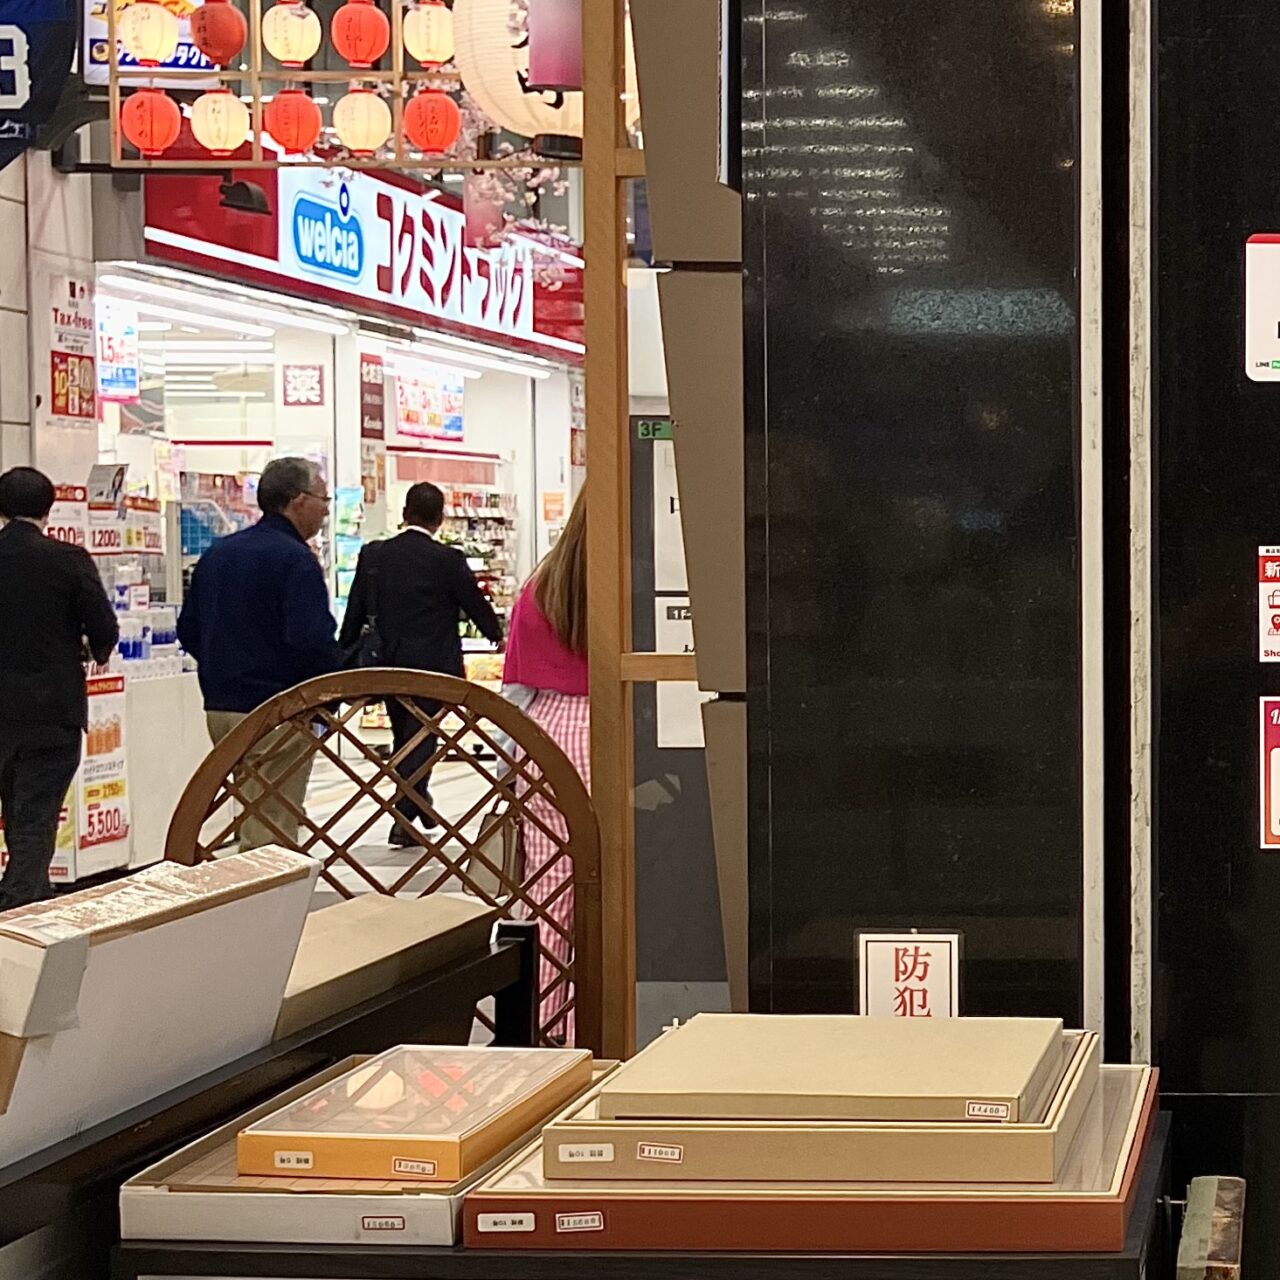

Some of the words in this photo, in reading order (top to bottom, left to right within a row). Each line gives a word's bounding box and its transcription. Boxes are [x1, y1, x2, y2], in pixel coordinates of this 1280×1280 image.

[297, 211, 359, 272] welcia
[641, 422, 662, 437] 3F
[893, 945, 932, 1017] 防犯
